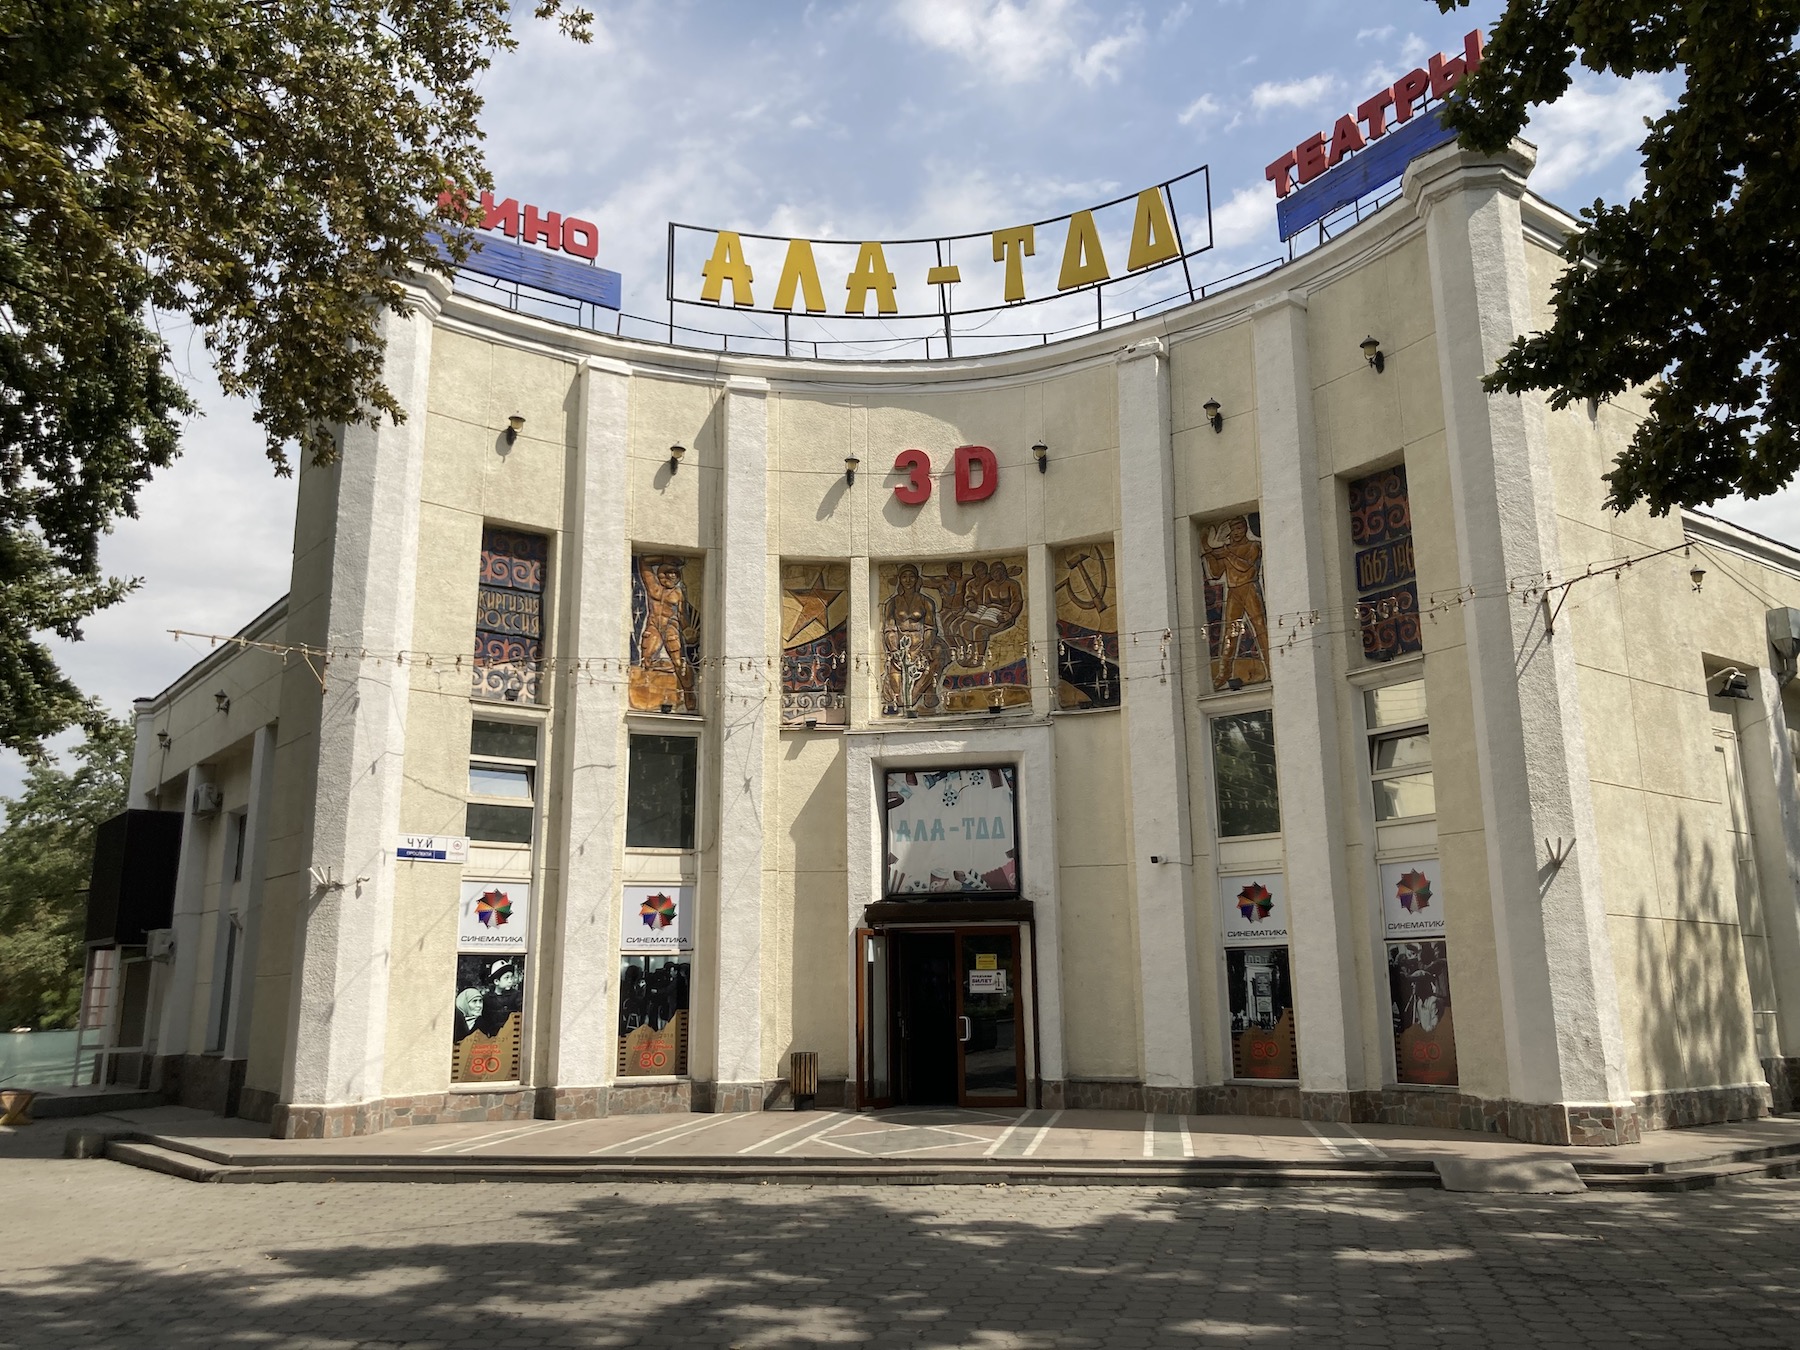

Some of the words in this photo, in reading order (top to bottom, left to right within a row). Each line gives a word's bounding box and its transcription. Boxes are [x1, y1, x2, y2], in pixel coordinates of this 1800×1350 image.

[1265, 28, 1484, 198] ТЕАТРЫ
[479, 590, 539, 614] КИРГИЗИЯ
[477, 607, 539, 636] РОССИЯ
[461, 935, 524, 943] СИНЕМАТИКА
[1227, 929, 1288, 938] СИНЕМАТИКА
[1252, 1041, 1280, 1058] 80
[1413, 1041, 1441, 1060] 80
[471, 1057, 500, 1074] 80
[640, 1052, 666, 1068] 80
